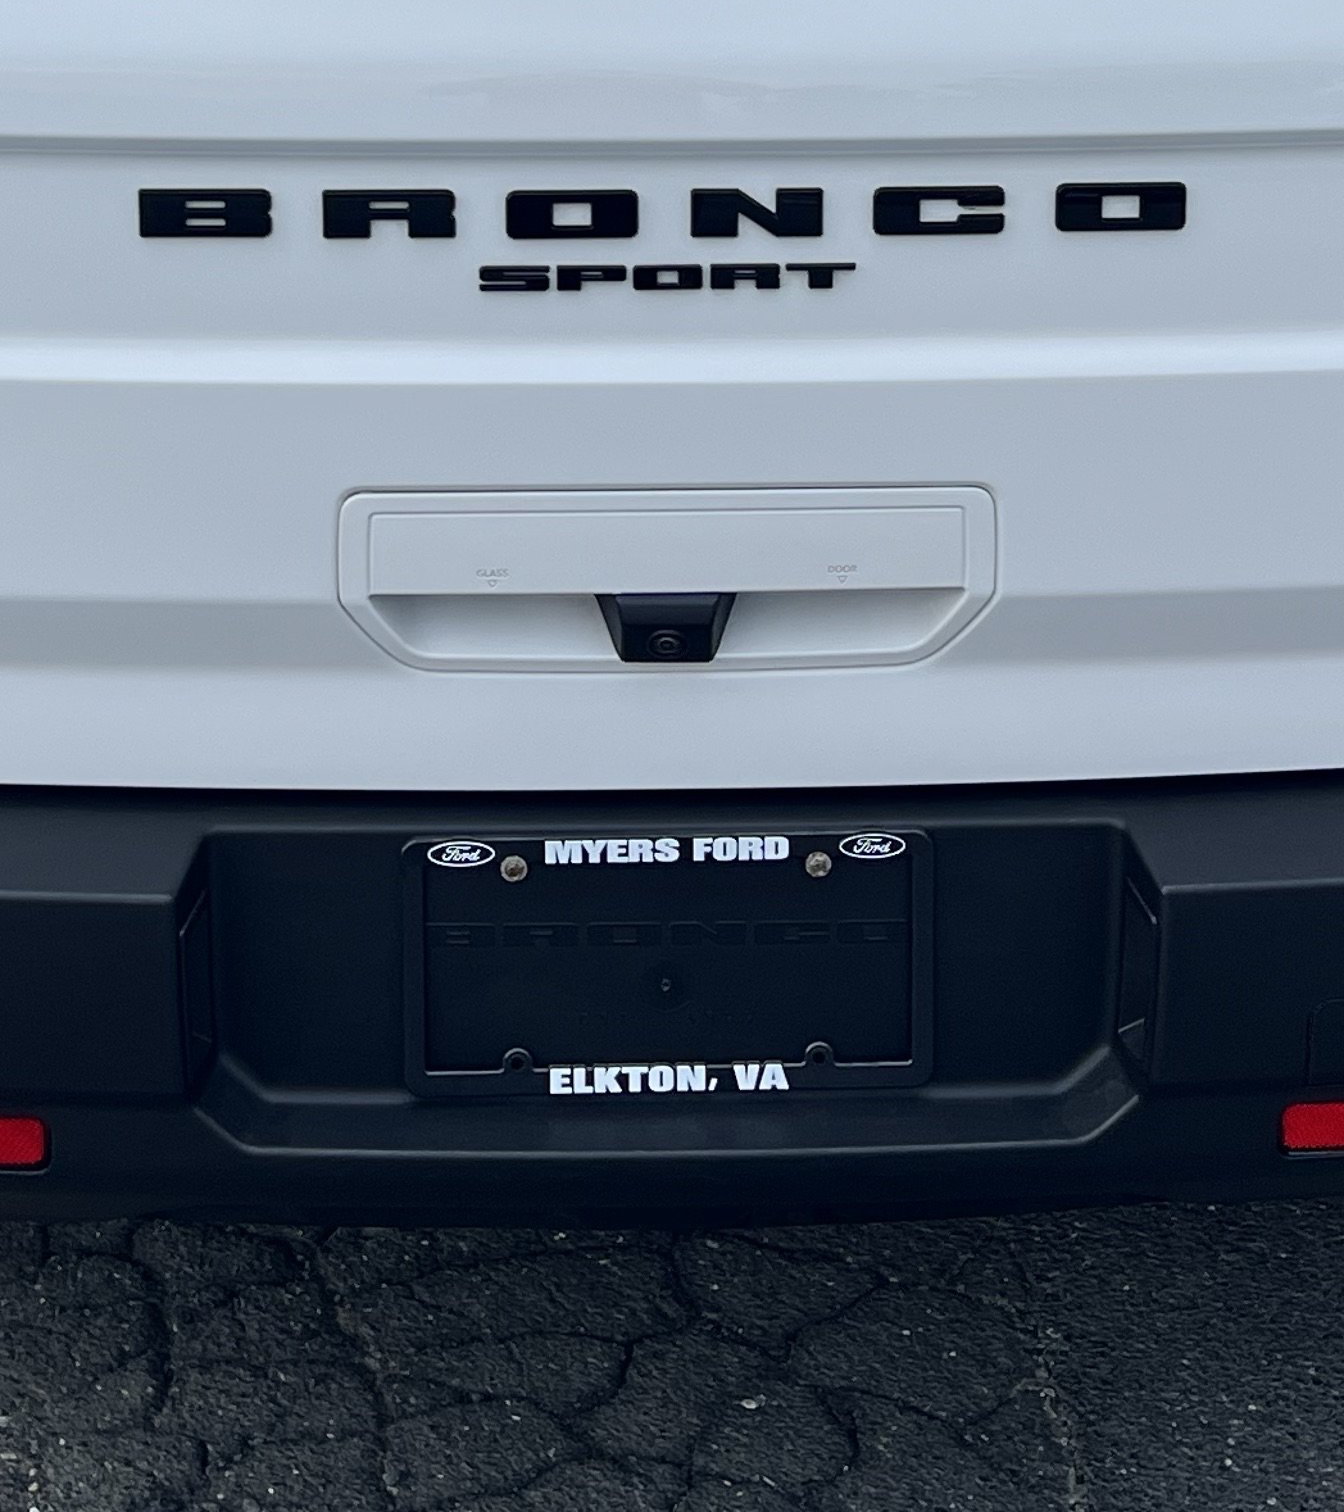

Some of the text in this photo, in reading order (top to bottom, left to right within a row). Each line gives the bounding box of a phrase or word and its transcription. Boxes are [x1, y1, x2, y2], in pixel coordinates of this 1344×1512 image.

[137, 182, 1188, 240] BRONCO
[478, 262, 857, 292] SPORT
[442, 835, 893, 865] Ford MYERS FORD Ford
[549, 1063, 790, 1095] ELKTON, VA
